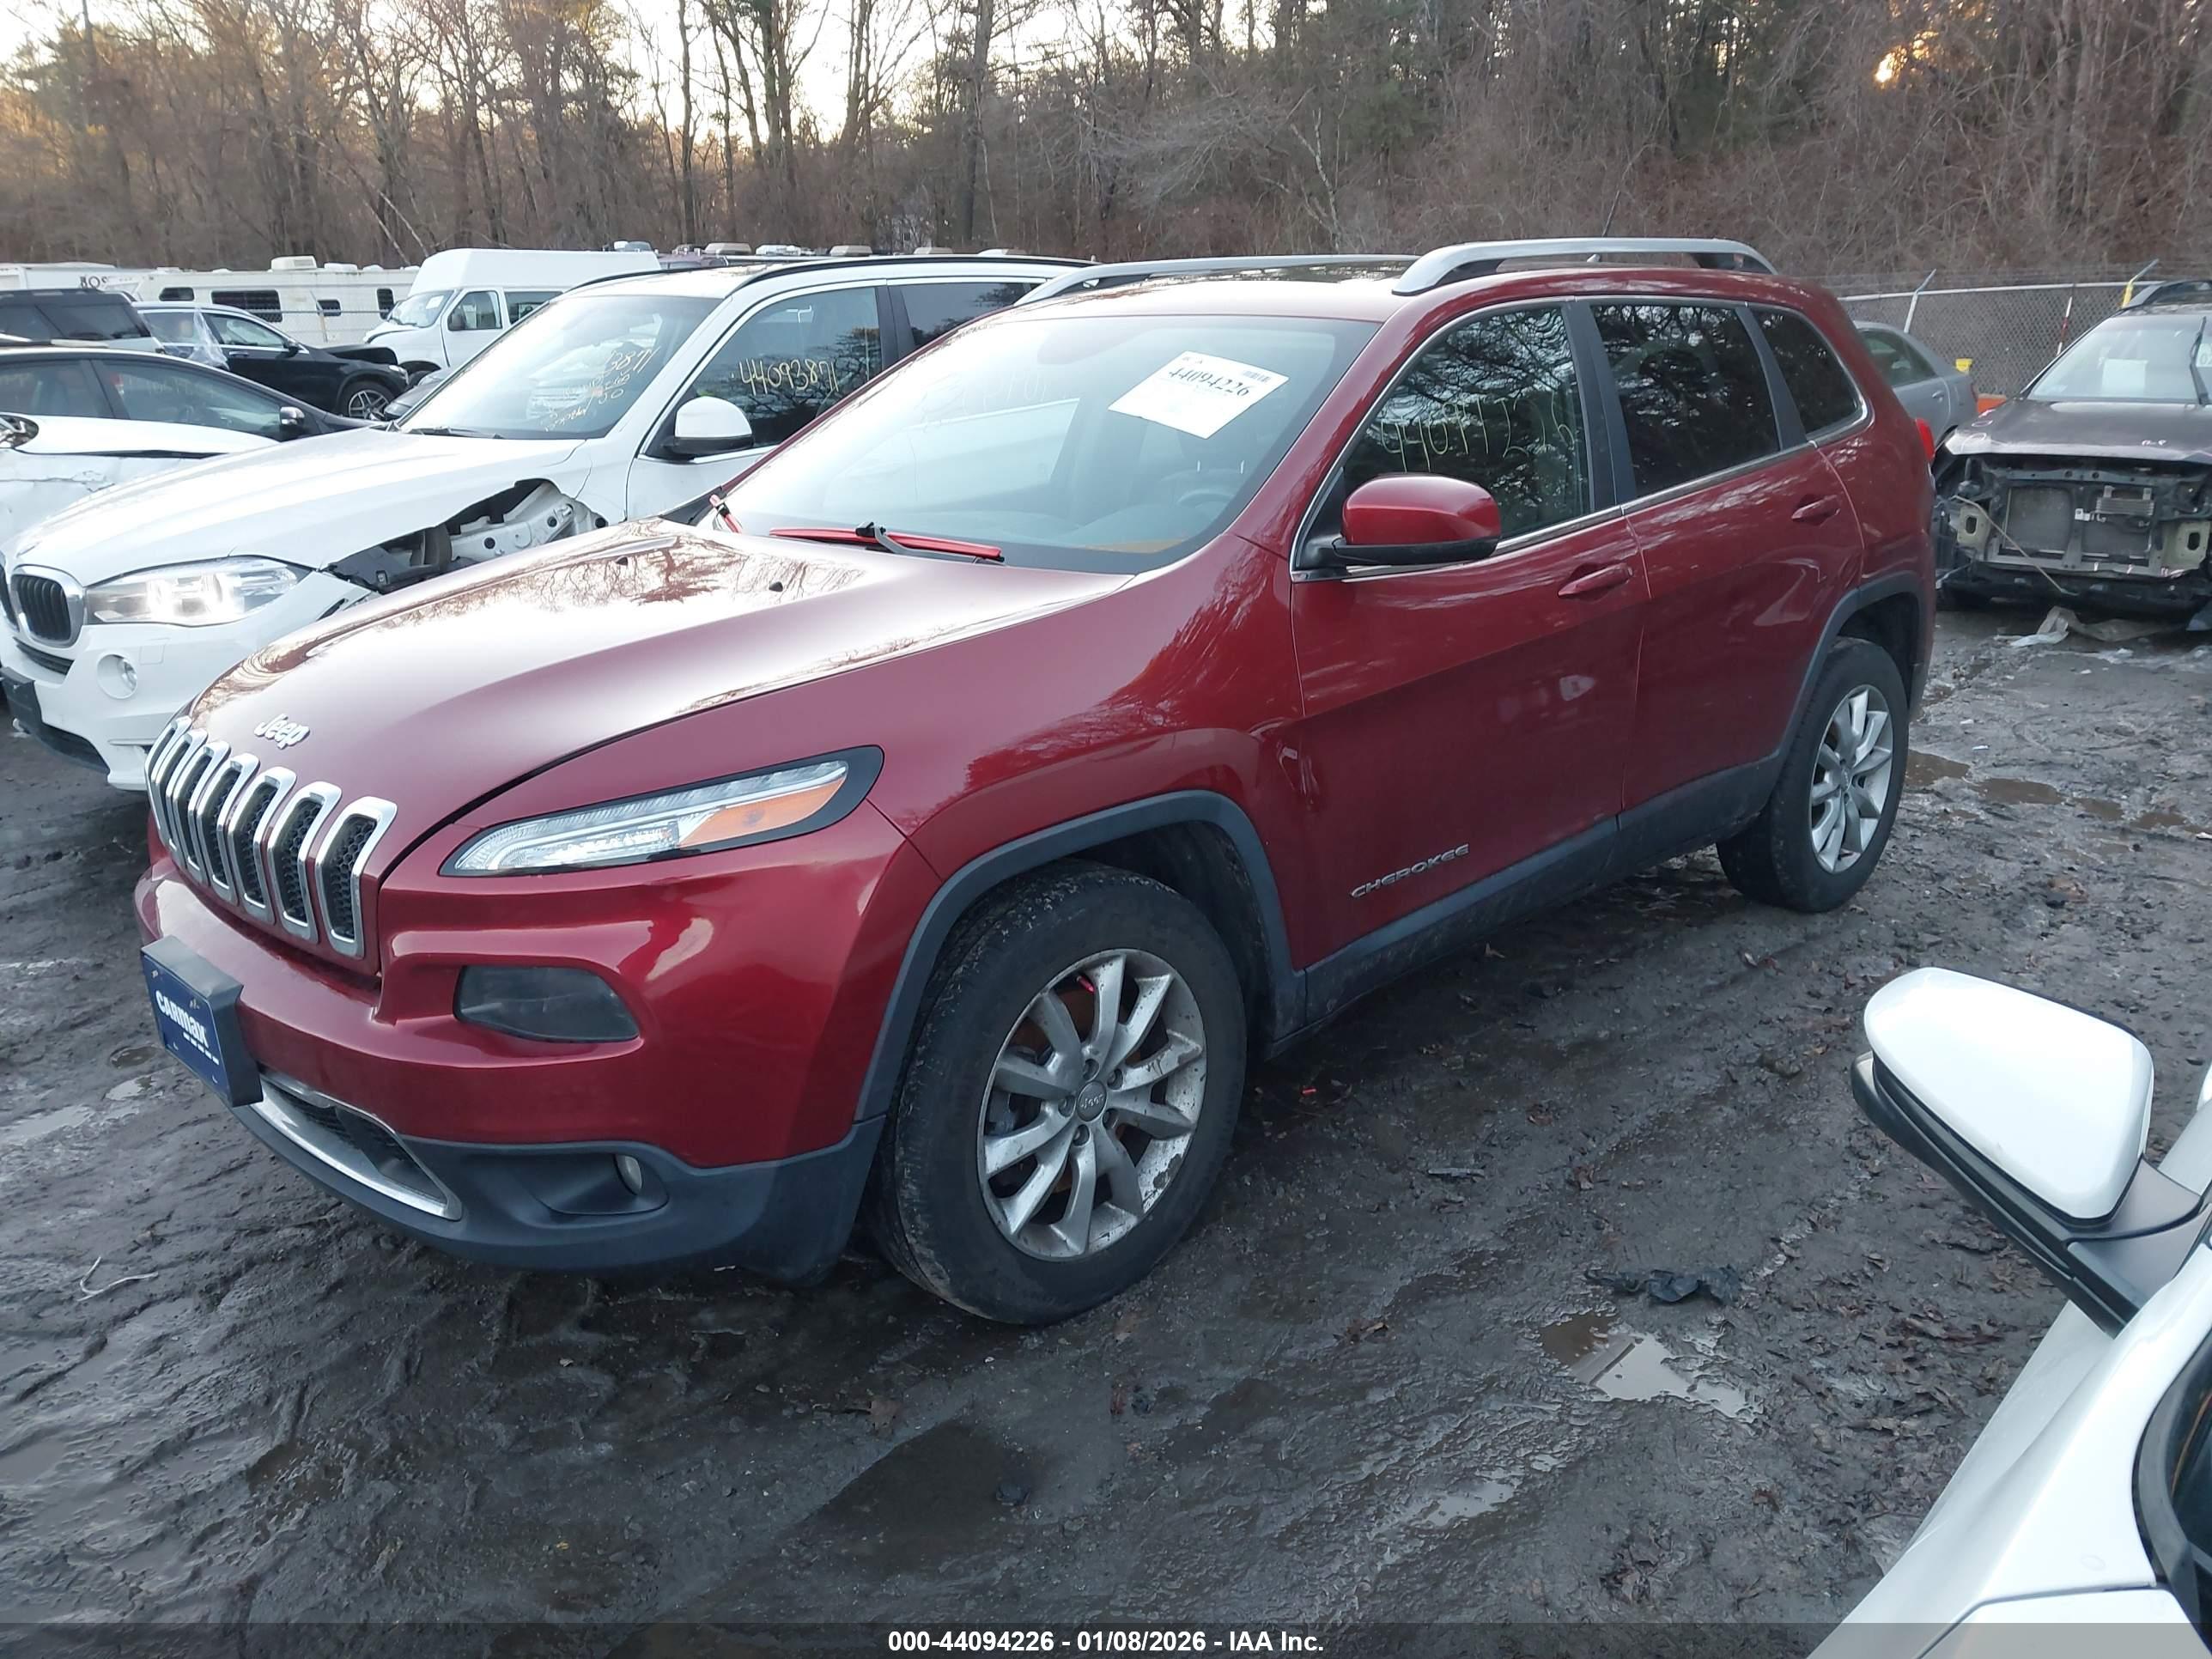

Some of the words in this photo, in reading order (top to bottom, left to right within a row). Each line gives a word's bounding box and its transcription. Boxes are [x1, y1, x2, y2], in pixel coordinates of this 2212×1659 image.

[738, 358, 839, 396] 44093871
[1169, 367, 1250, 397] 44094226
[253, 713, 310, 750] Jeep
[1351, 843, 1469, 898] CHEROKEE
